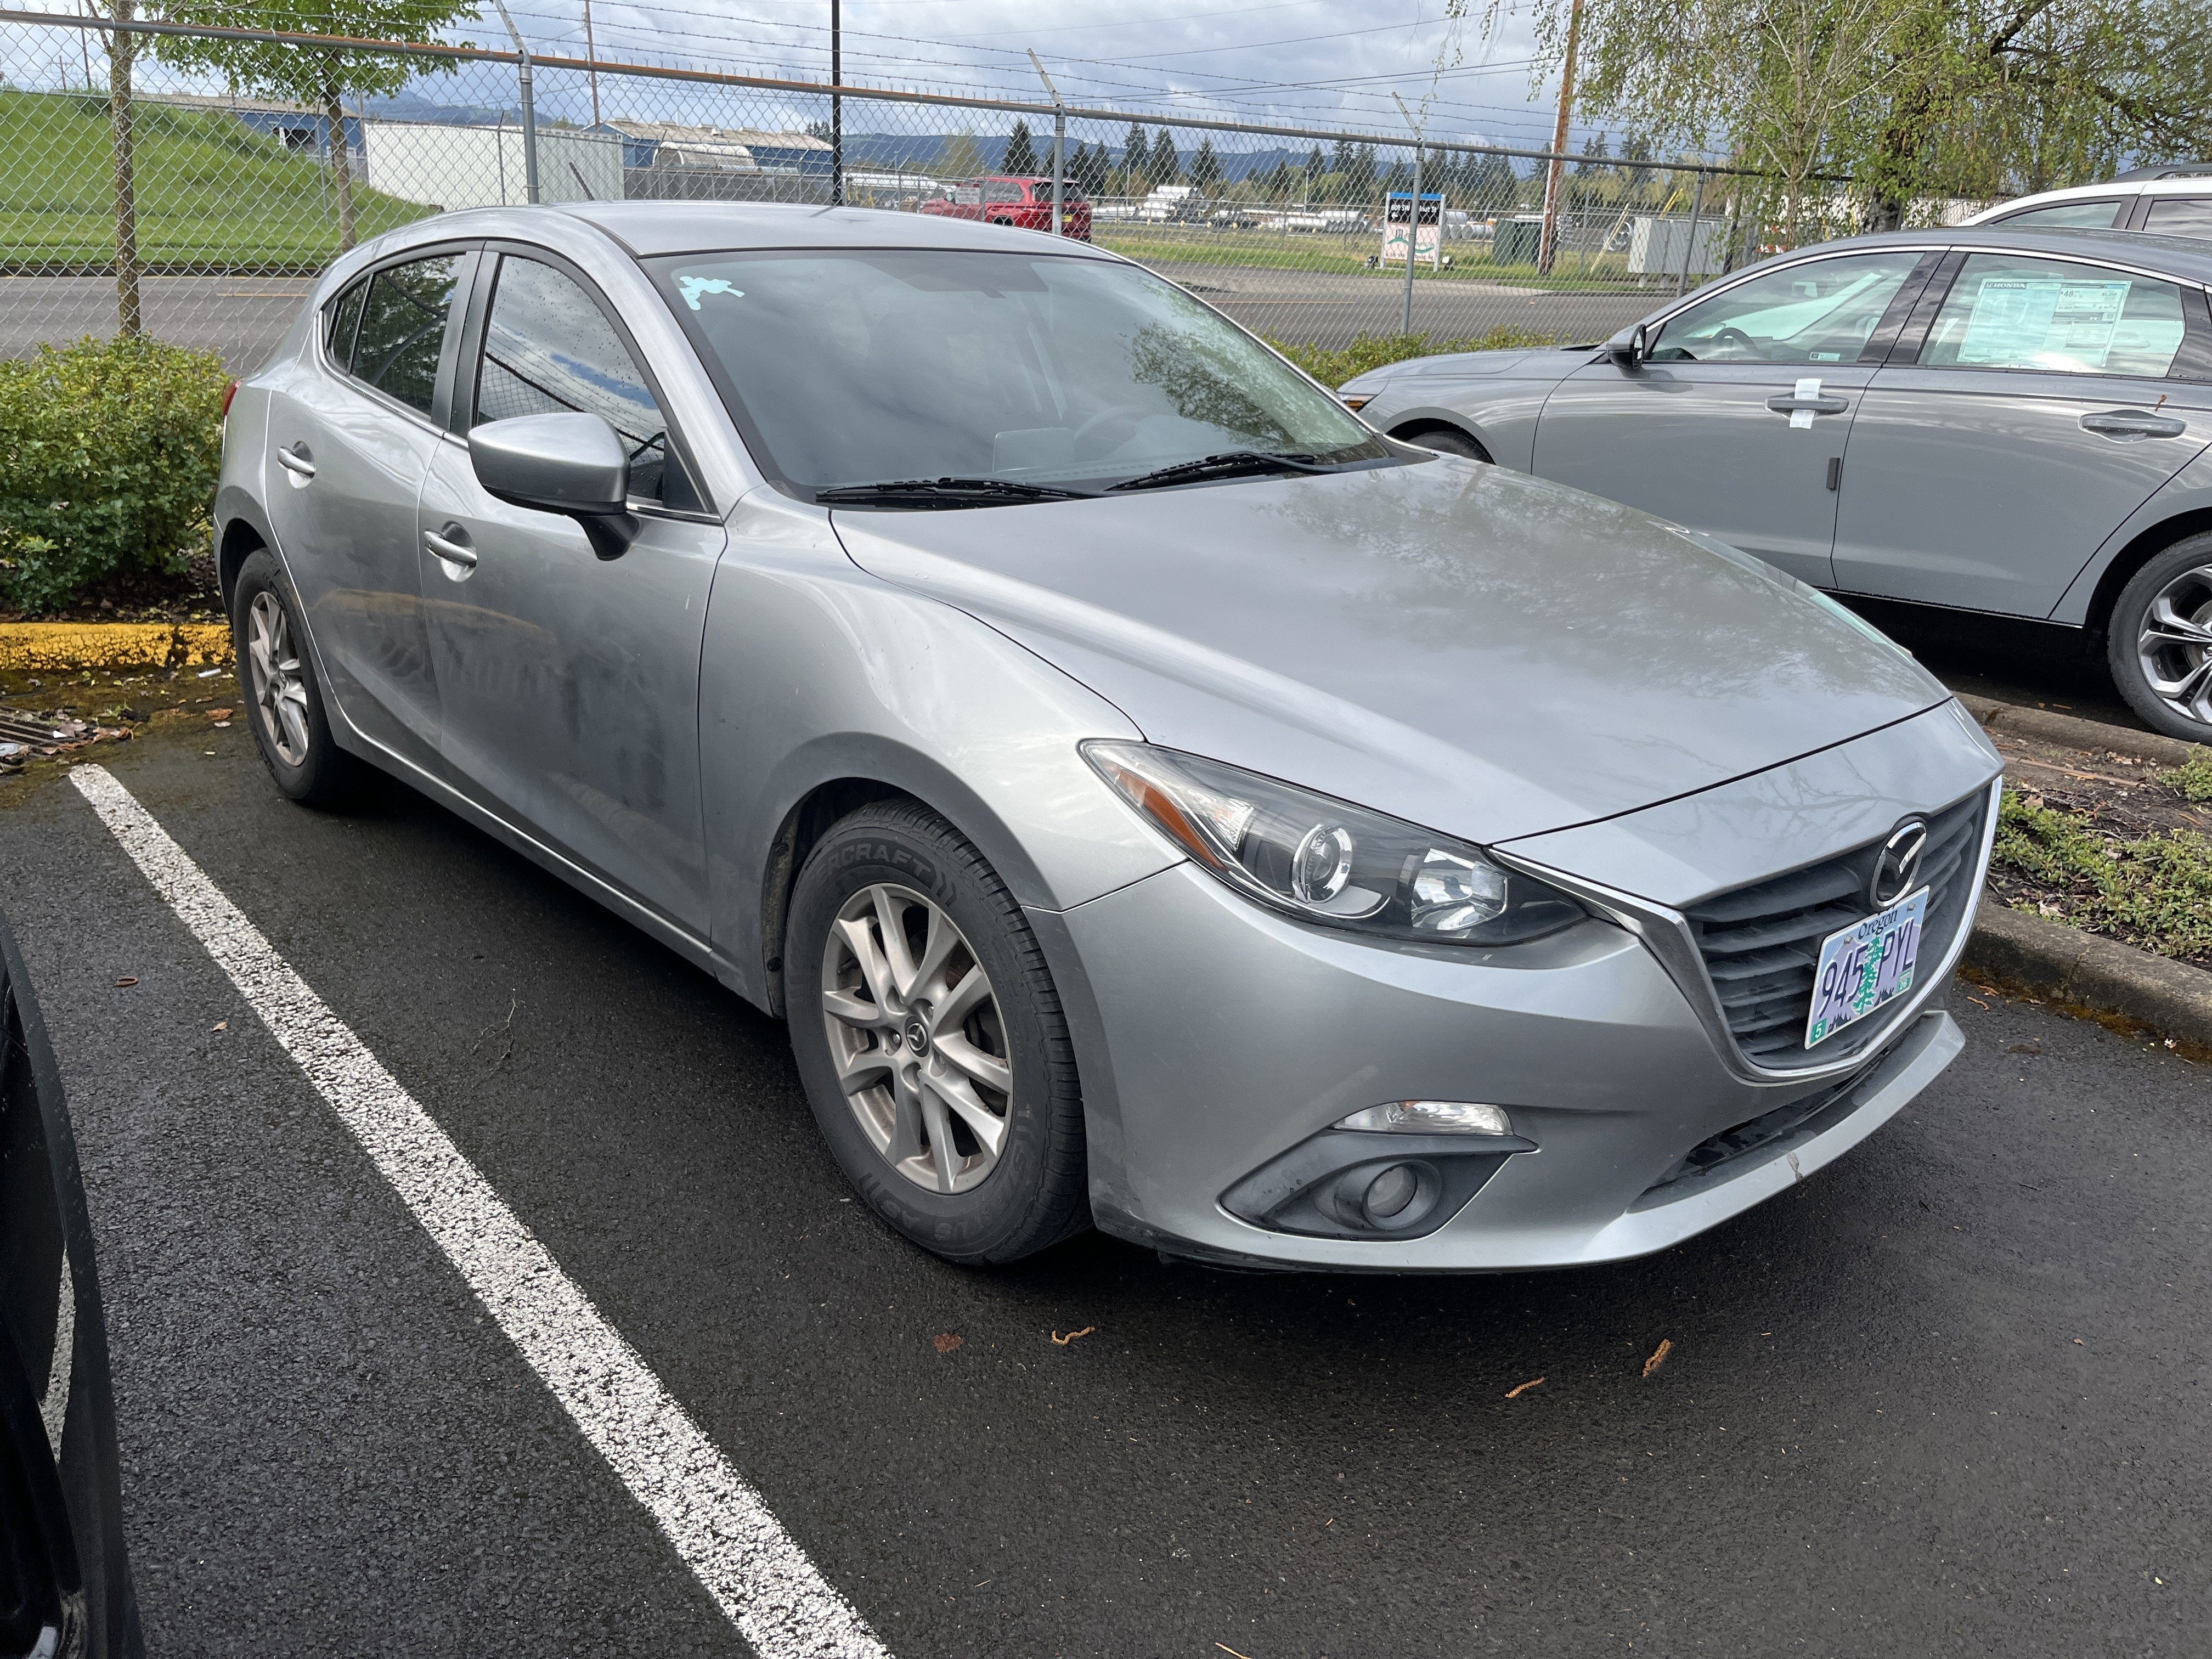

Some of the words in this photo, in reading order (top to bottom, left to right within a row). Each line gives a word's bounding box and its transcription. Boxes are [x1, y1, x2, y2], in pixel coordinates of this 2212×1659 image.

[1858, 909, 1898, 939] Oregon
[1817, 944, 1869, 1018] 945
[1875, 919, 1915, 988] PYL
[1815, 1022, 1822, 1039] 5
